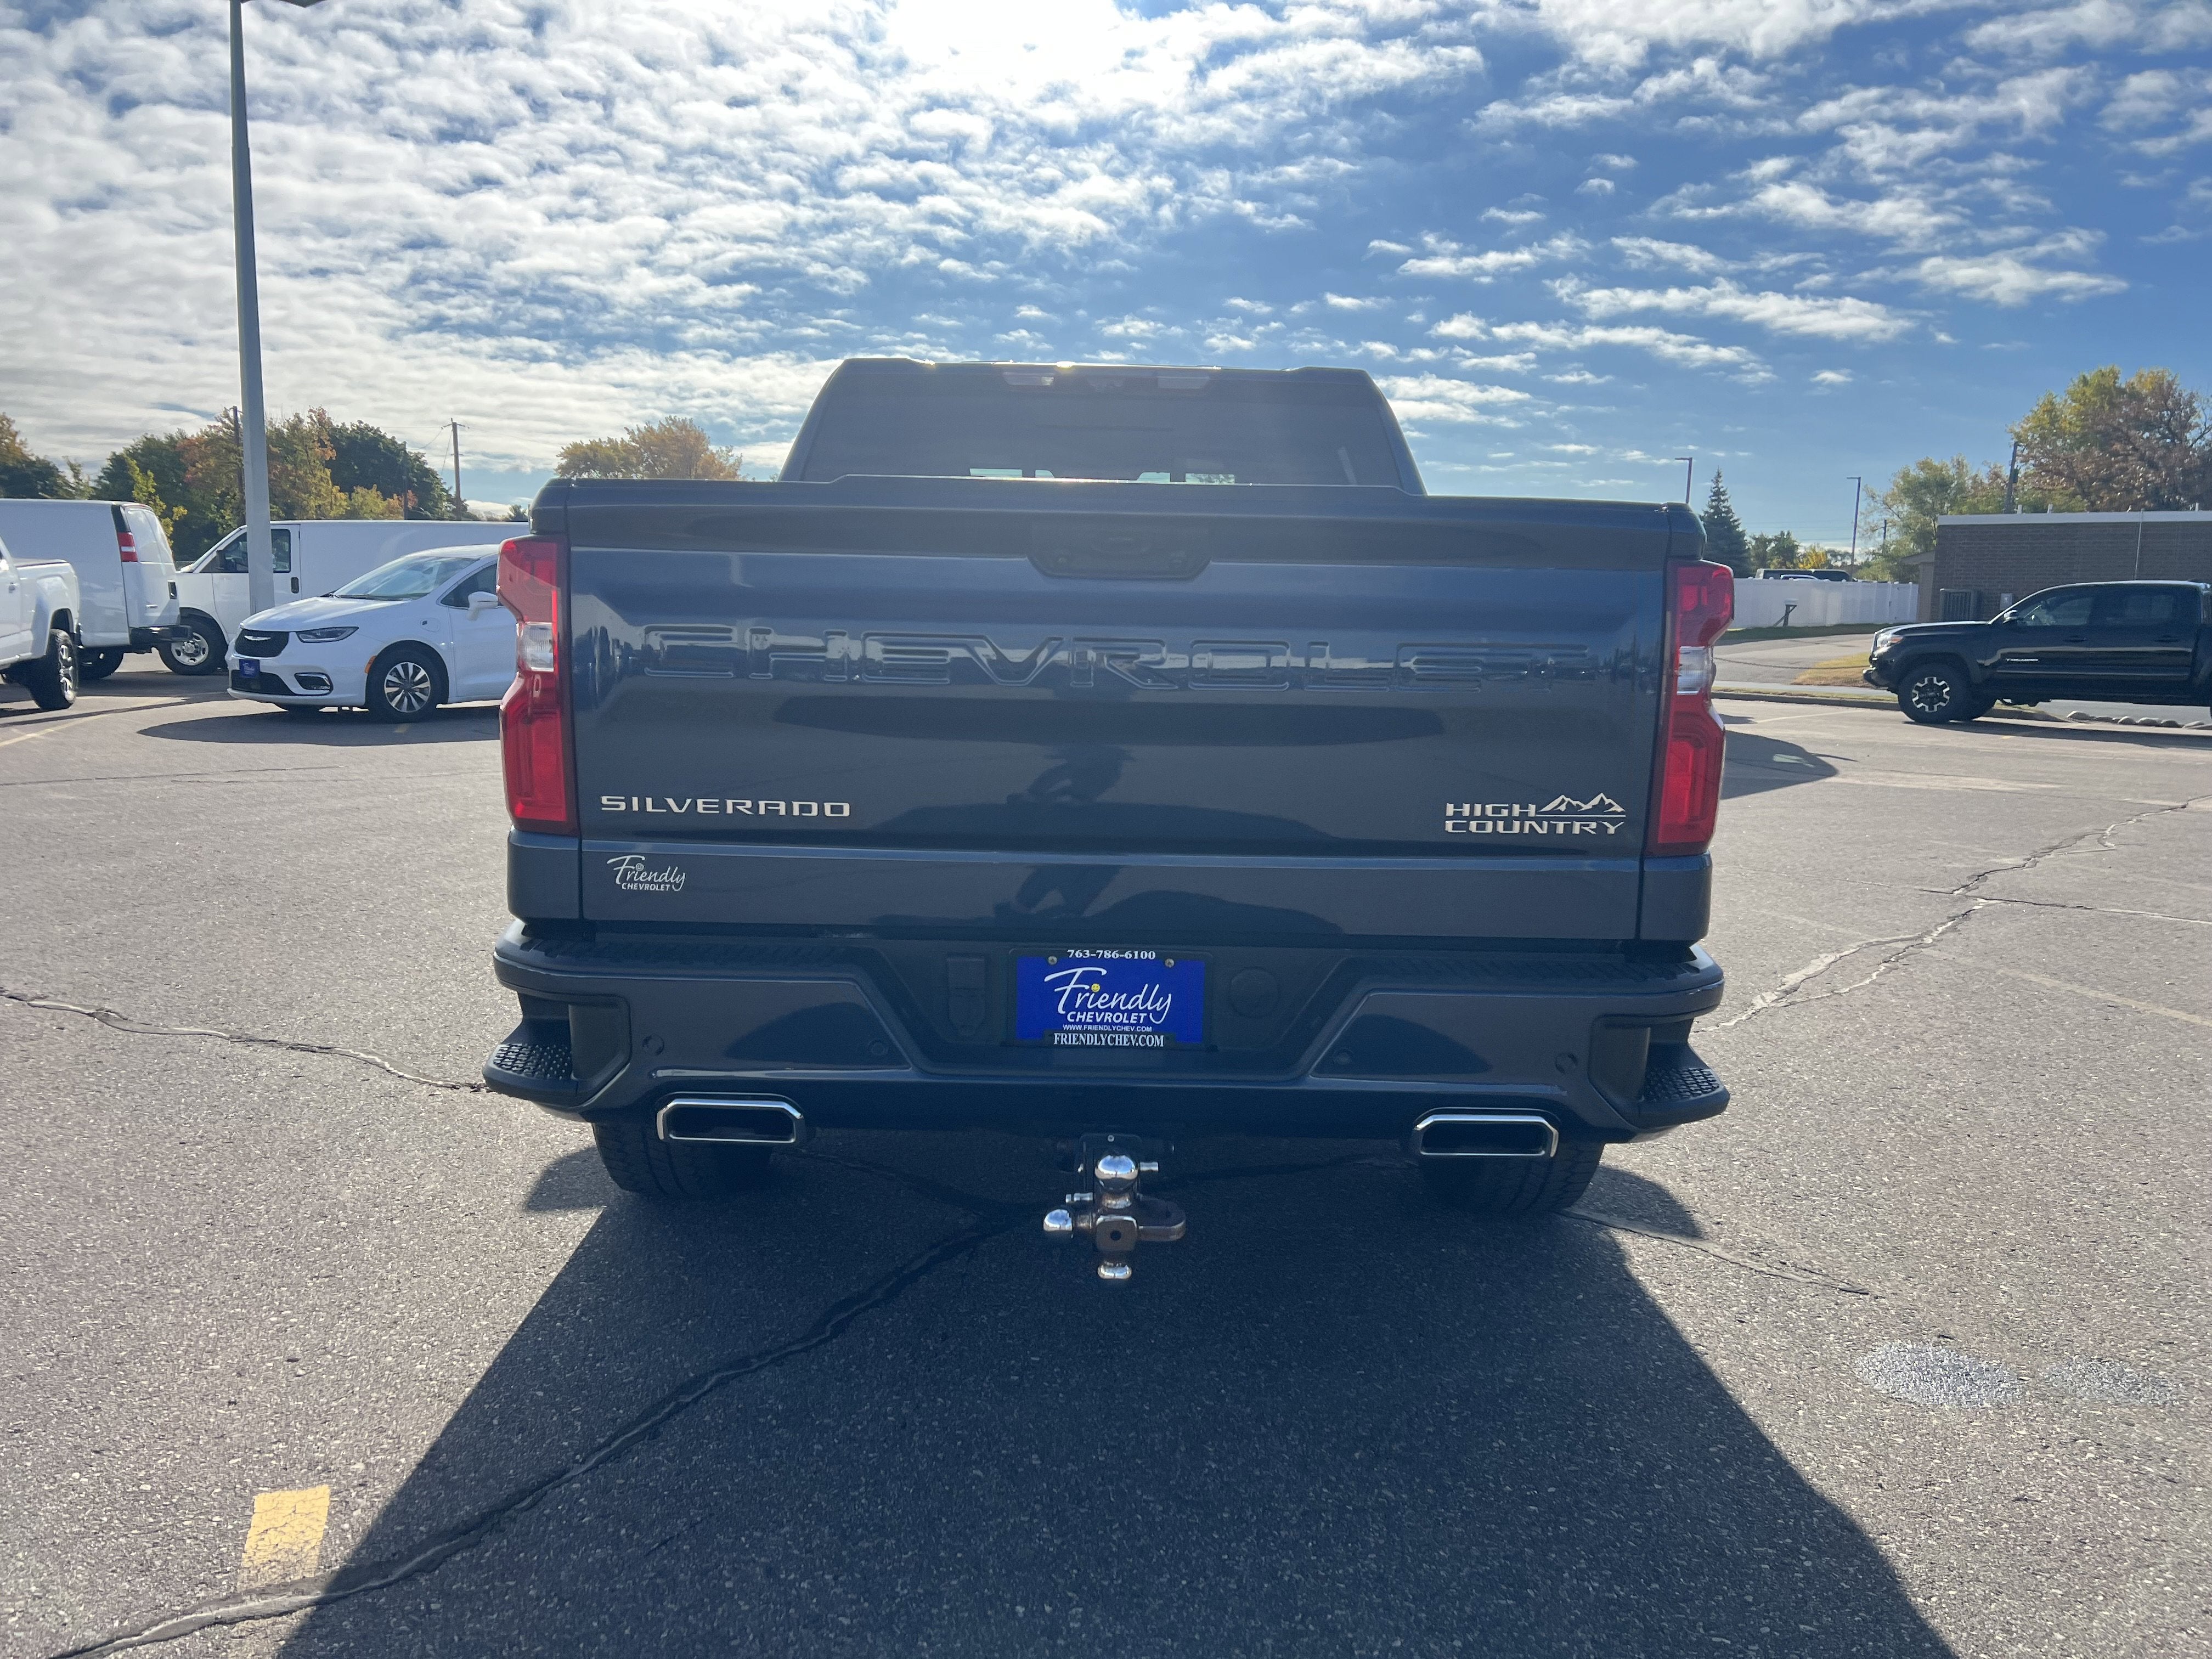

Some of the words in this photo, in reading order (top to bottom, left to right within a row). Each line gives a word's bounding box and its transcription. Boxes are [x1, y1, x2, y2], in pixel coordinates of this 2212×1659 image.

[644, 623, 1589, 693] CHEVROLET
[600, 795, 851, 817] SILVERADO
[1445, 803, 1537, 817] HIGH
[1444, 820, 1624, 834] COUNTRY
[607, 855, 686, 891] Friendly
[621, 882, 670, 891] CHEVROLET
[1066, 949, 1156, 960] 763-786-6100
[1044, 967, 1172, 1024] Friendly
[1066, 1011, 1148, 1024] CHEVROLET
[1062, 1024, 1153, 1032] WWW.FRIENDLYCHEV.COM
[1053, 1032, 1165, 1047] FRIENDLYCHEV.COM
